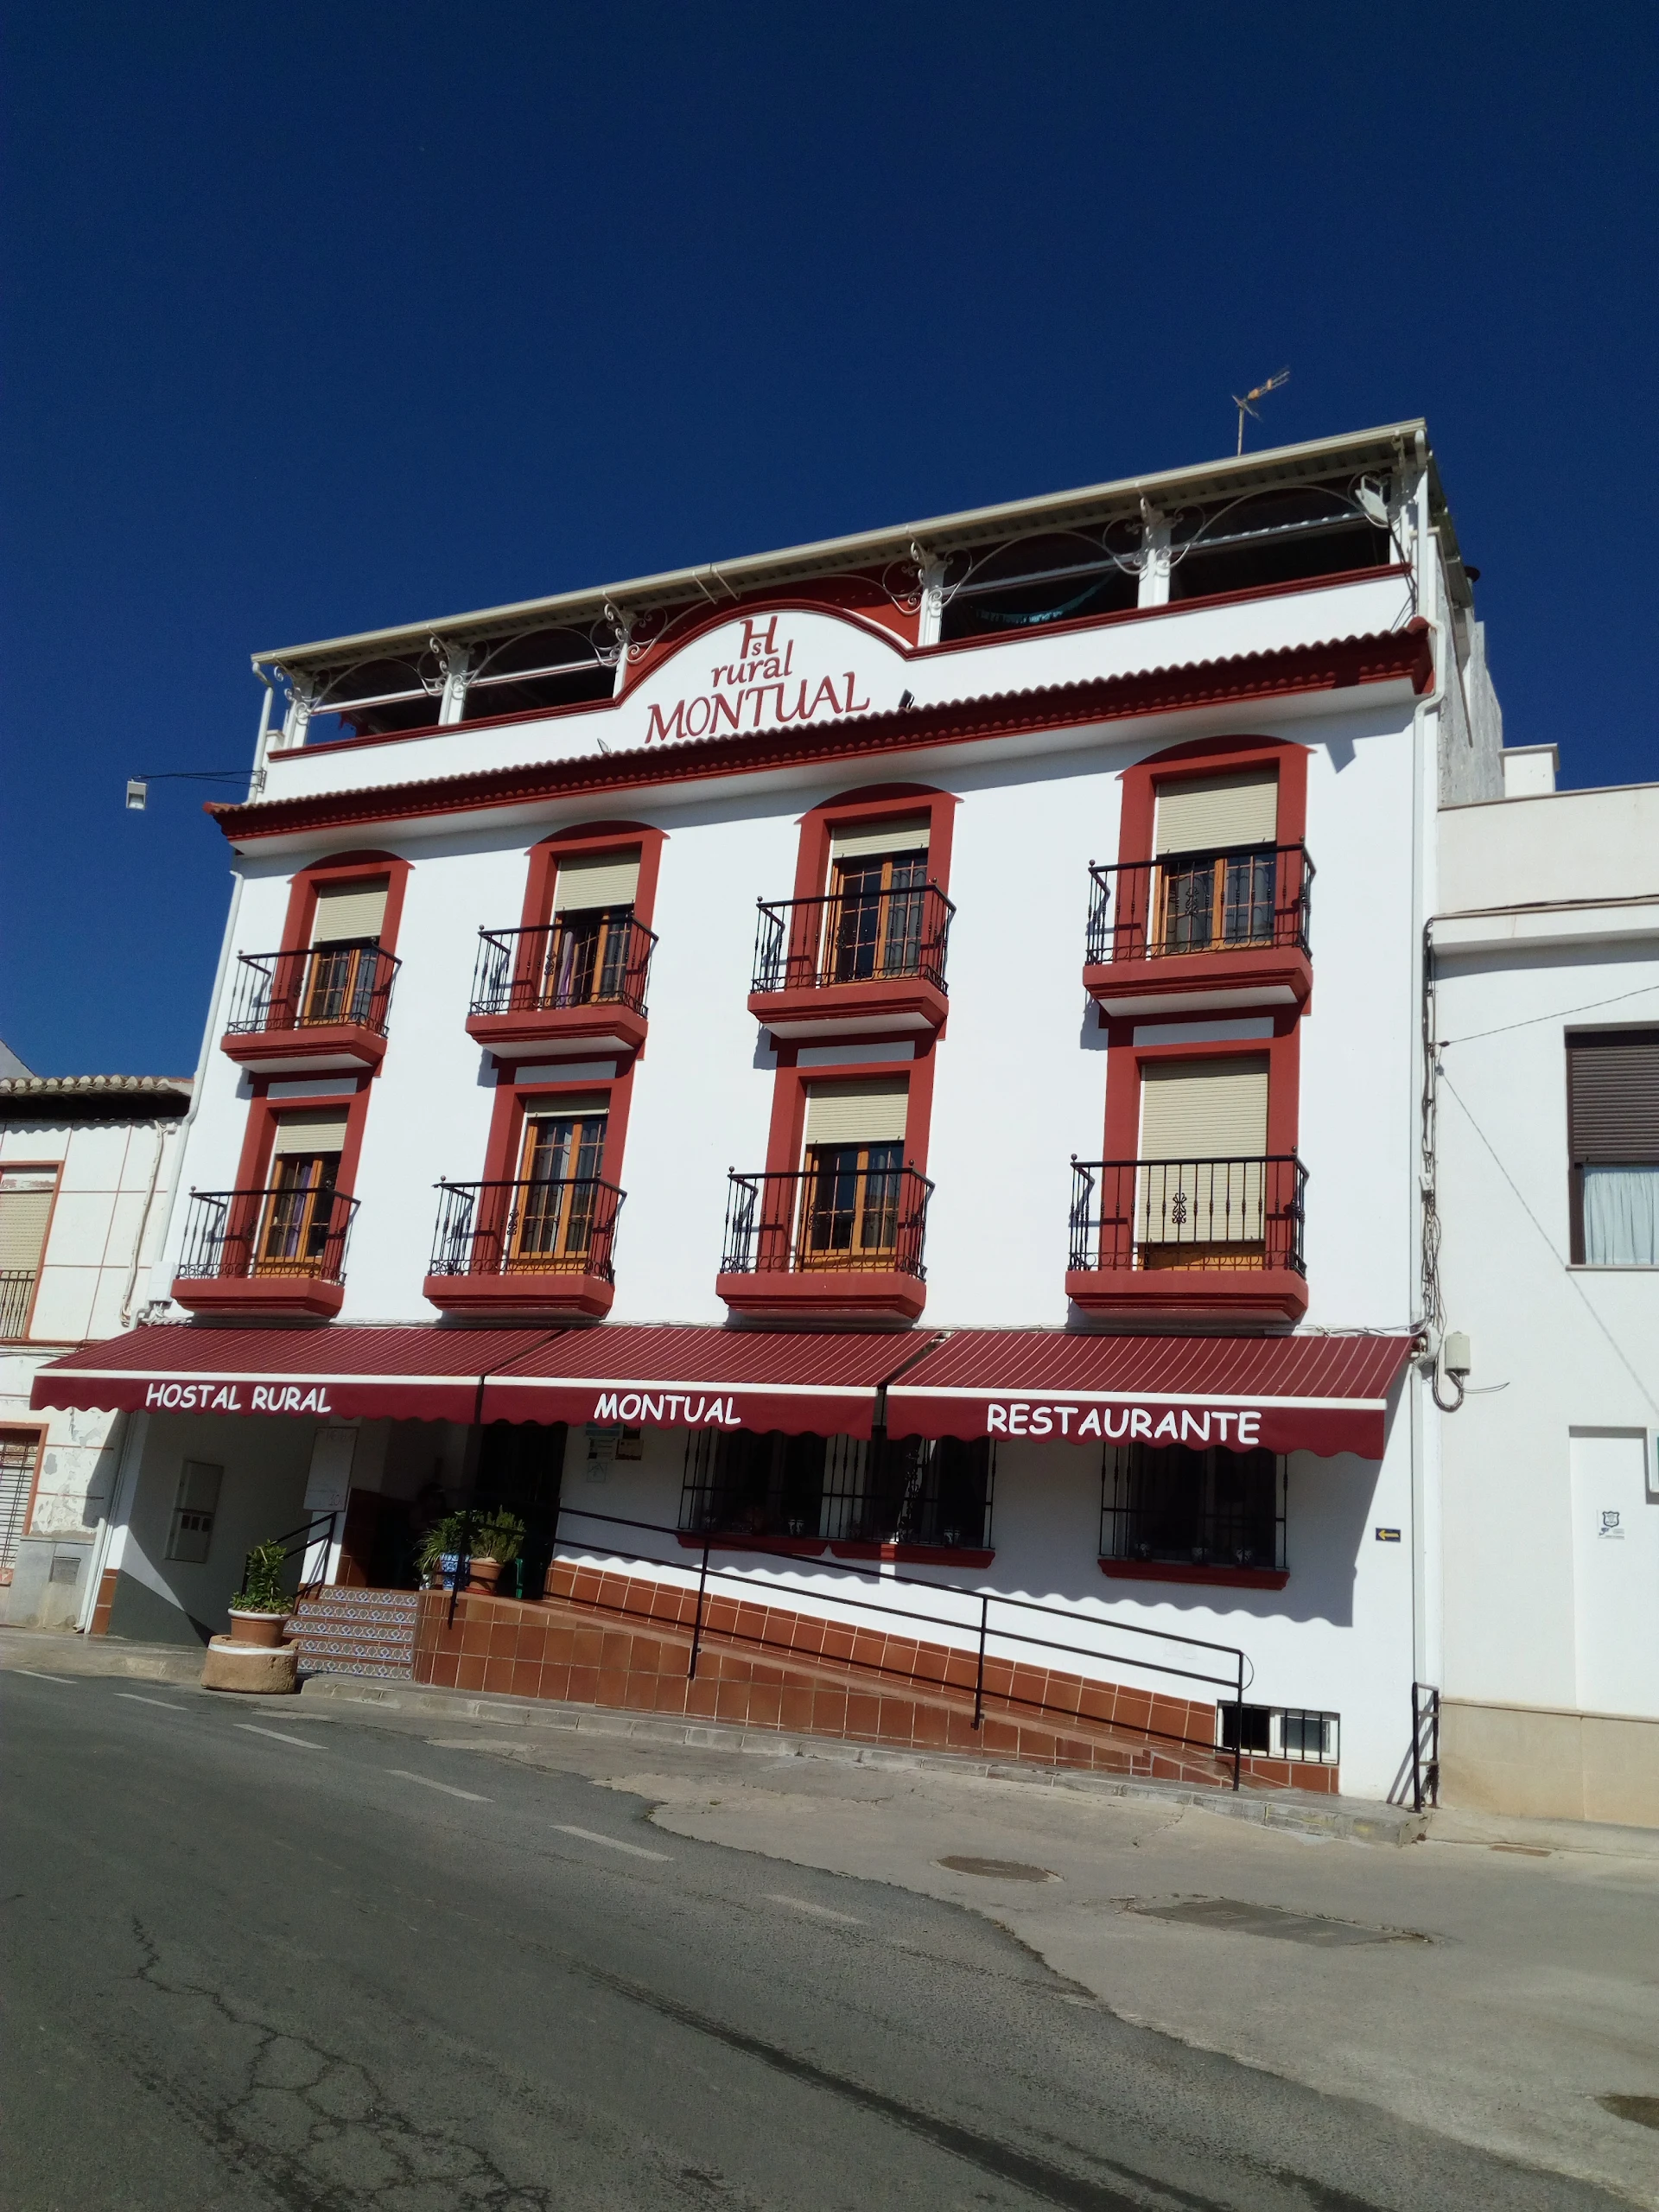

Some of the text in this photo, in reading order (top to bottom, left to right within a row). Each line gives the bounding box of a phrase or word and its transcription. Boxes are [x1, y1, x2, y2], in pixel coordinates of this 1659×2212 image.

[710, 639, 793, 688] rural
[644, 671, 870, 745] MONTUAL
[145, 1382, 332, 1414] HOSTAL RURAL
[594, 1392, 742, 1425] MONTUAL
[986, 1402, 1263, 1445] RESTAURANTE
